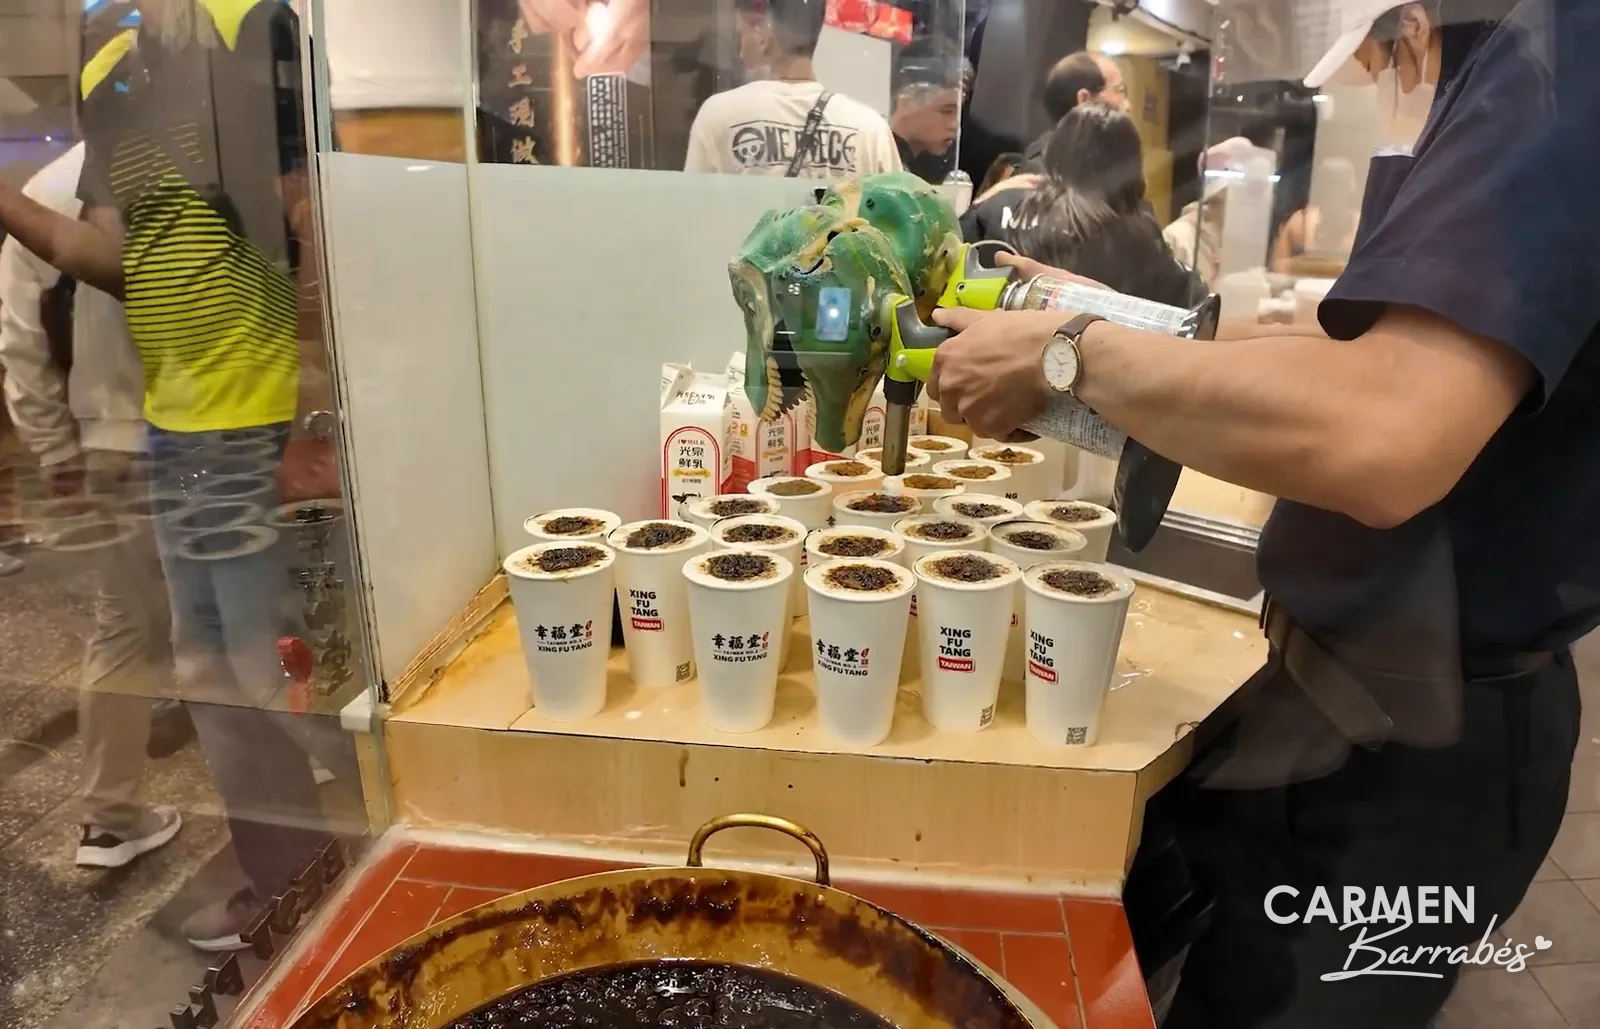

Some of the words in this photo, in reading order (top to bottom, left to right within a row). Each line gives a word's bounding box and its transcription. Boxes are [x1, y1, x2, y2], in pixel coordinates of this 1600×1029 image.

[679, 446, 704, 457] 光泉
[629, 588, 657, 600] XING
[636, 599, 650, 608] FU
[630, 606, 659, 617] TANG
[633, 620, 661, 629] TAIWAN
[534, 623, 584, 640] 幸福堂
[940, 626, 972, 638] XING
[711, 633, 761, 649] 幸福堂
[947, 637, 963, 648] FU
[1030, 629, 1054, 647] XING
[537, 644, 558, 653] XING
[571, 640, 593, 651] TANG
[816, 638, 860, 662] 幸福堂
[939, 645, 971, 657] TANG
[1034, 641, 1046, 655] FU
[713, 653, 734, 662] XING
[747, 651, 768, 662] TANG
[1029, 648, 1054, 667] TANG
[833, 666, 843, 674] FU
[940, 660, 972, 670] TAIWAN
